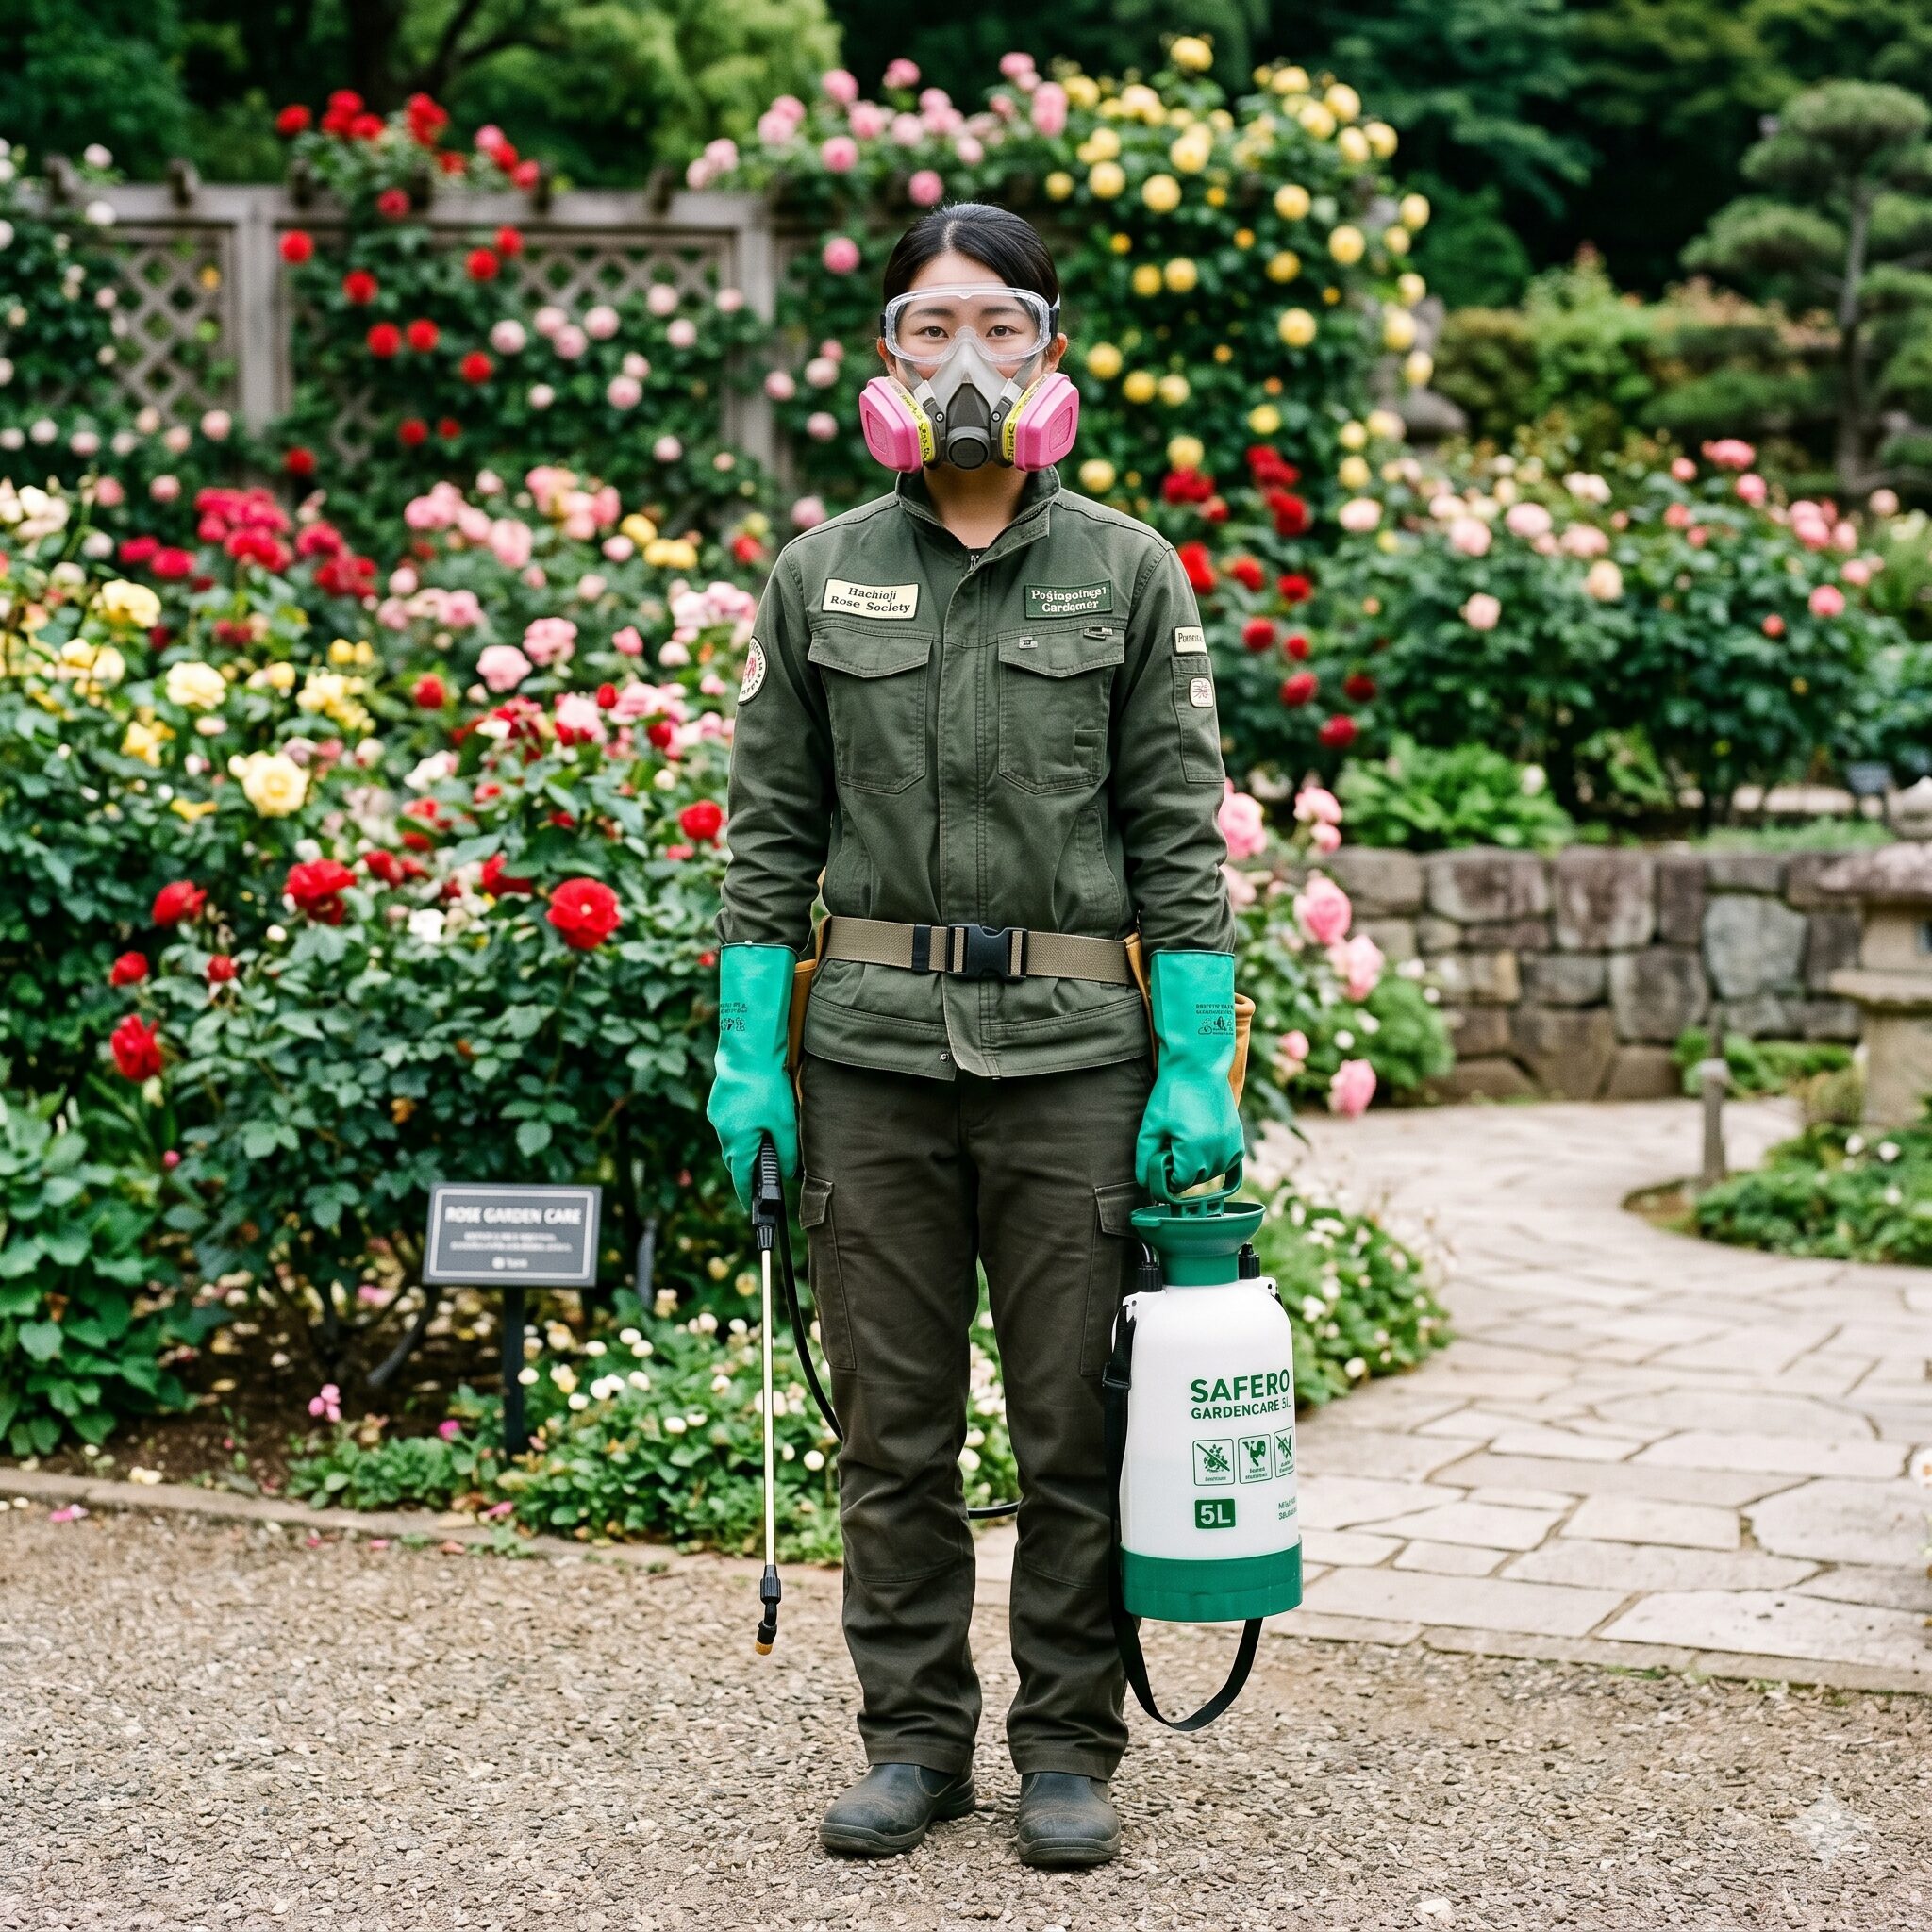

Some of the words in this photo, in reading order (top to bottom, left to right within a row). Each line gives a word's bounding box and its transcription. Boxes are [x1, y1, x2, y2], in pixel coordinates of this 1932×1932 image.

[830, 595, 860, 608] Rose
[483, 1206, 542, 1224] GARDEN
[543, 1208, 582, 1224] CARE
[1191, 1369, 1290, 1403] SAFERO
[1191, 1399, 1280, 1419] GARDENCARE
[1200, 1504, 1231, 1524] 5L
